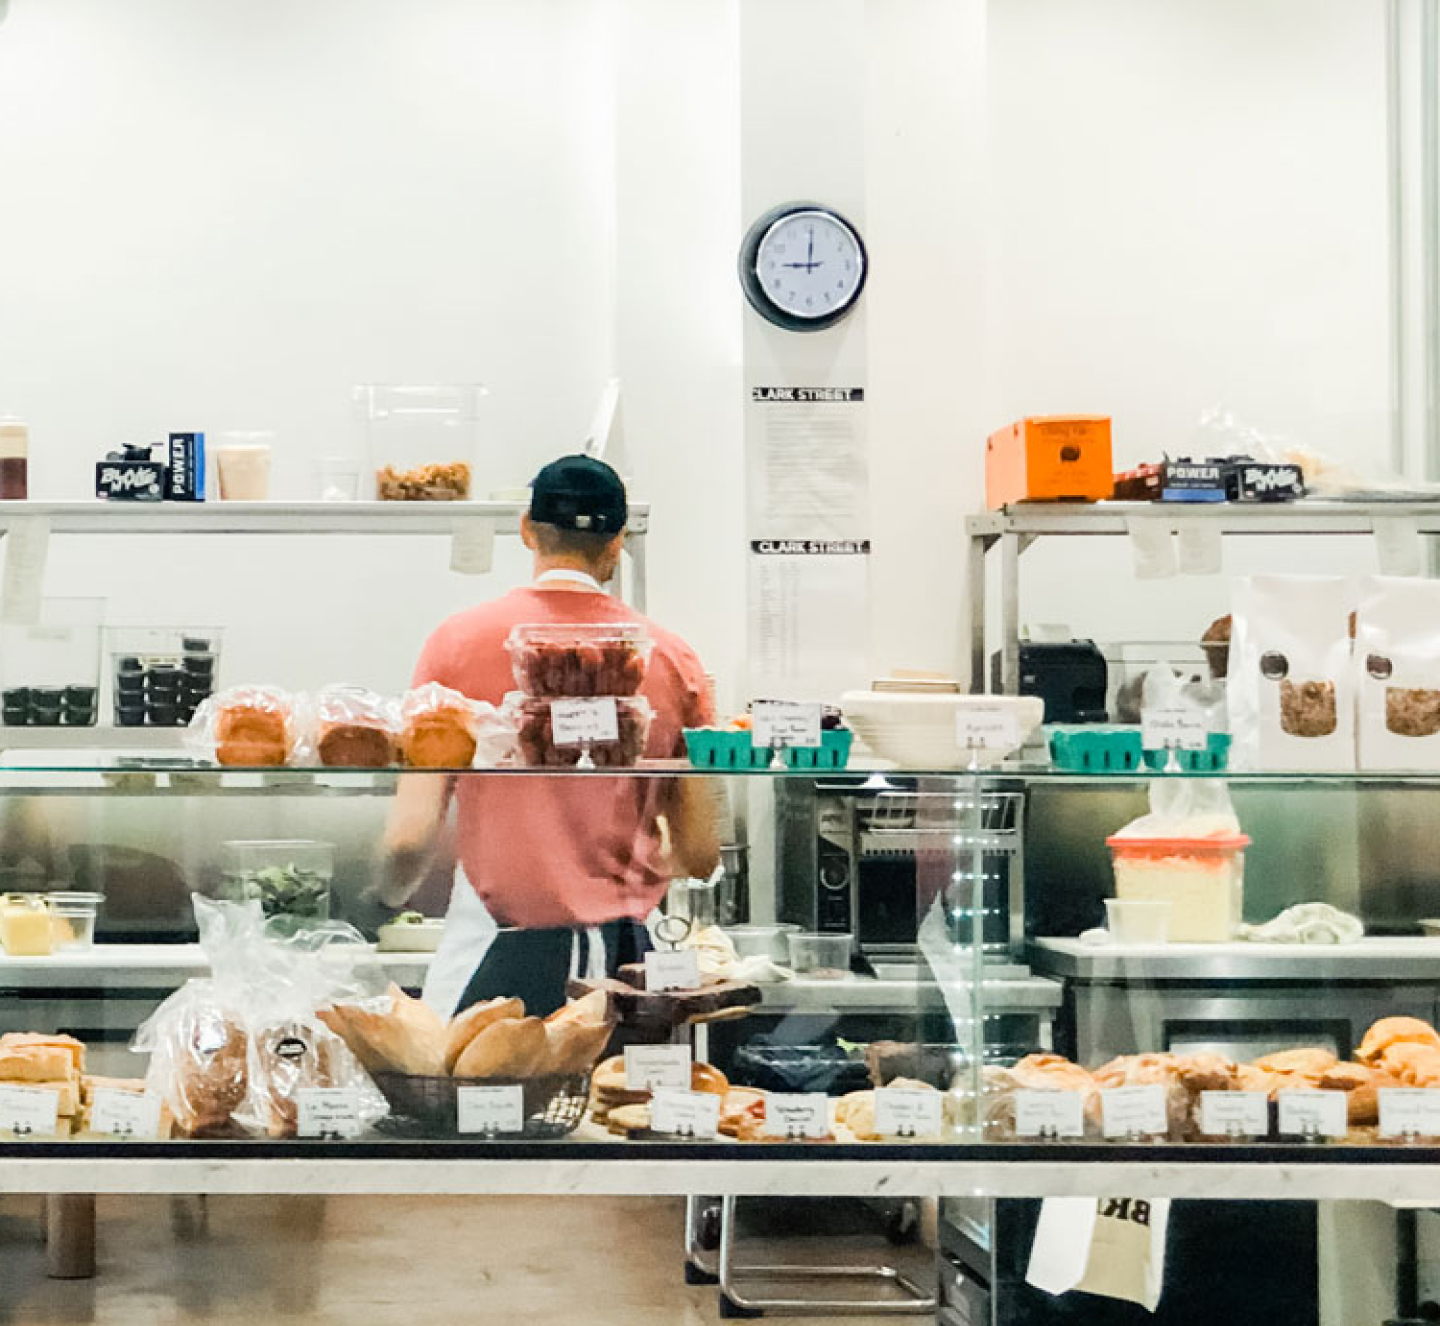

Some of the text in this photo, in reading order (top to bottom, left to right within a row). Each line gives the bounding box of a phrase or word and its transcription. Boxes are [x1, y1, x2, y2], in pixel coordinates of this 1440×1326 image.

[799, 387, 854, 402] STREET
[172, 438, 185, 494] POWER
[1166, 466, 1220, 480] POWER
[758, 540, 865, 554] CLARK STREET
